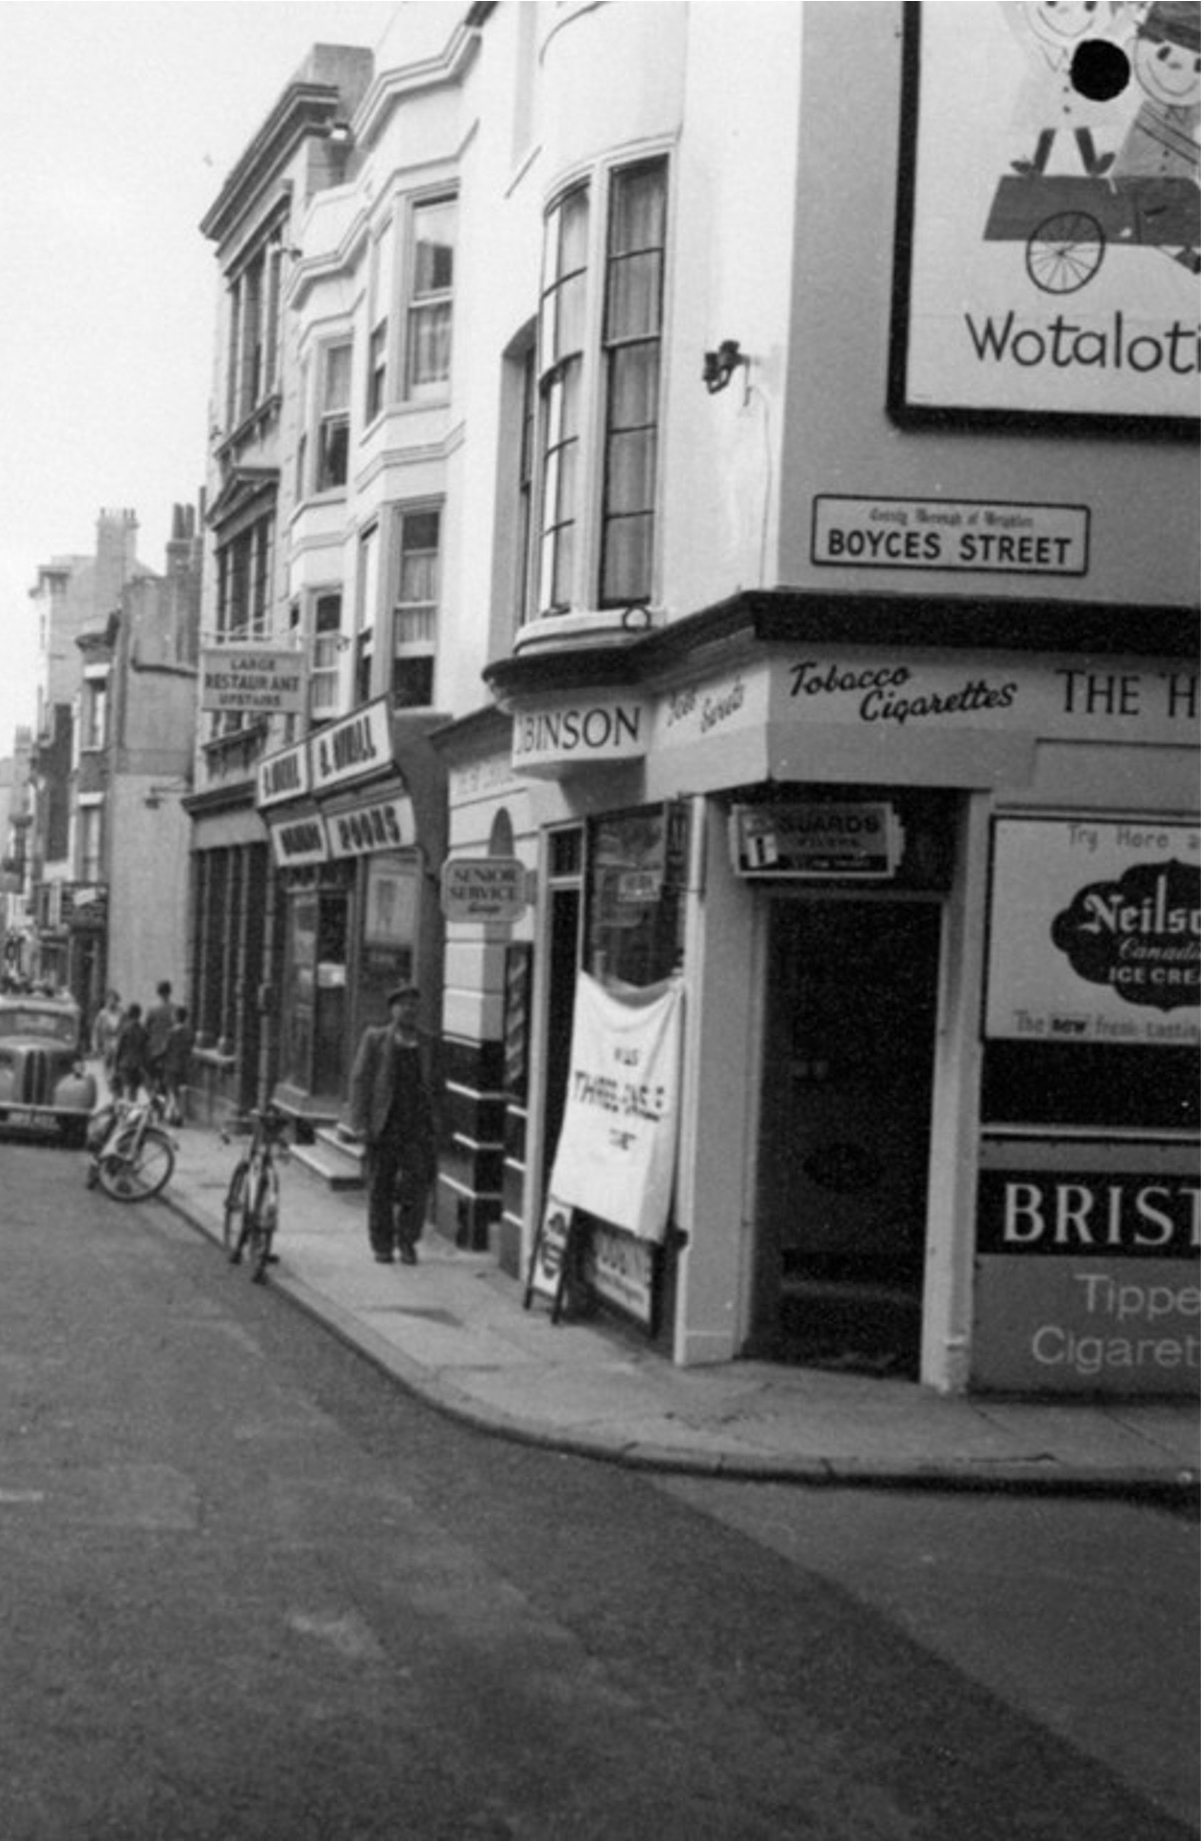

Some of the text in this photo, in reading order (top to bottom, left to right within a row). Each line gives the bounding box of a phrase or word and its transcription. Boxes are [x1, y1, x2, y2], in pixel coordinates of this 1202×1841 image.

[827, 528, 1073, 565] BOYCES STREET
[204, 673, 299, 692] RESTAURANT
[789, 660, 912, 697] Tobacco
[1054, 668, 1141, 716] THE
[859, 680, 1018, 725] Cigarettes
[1116, 827, 1169, 849] Here
[1109, 966, 1200, 987] ICE CRE
